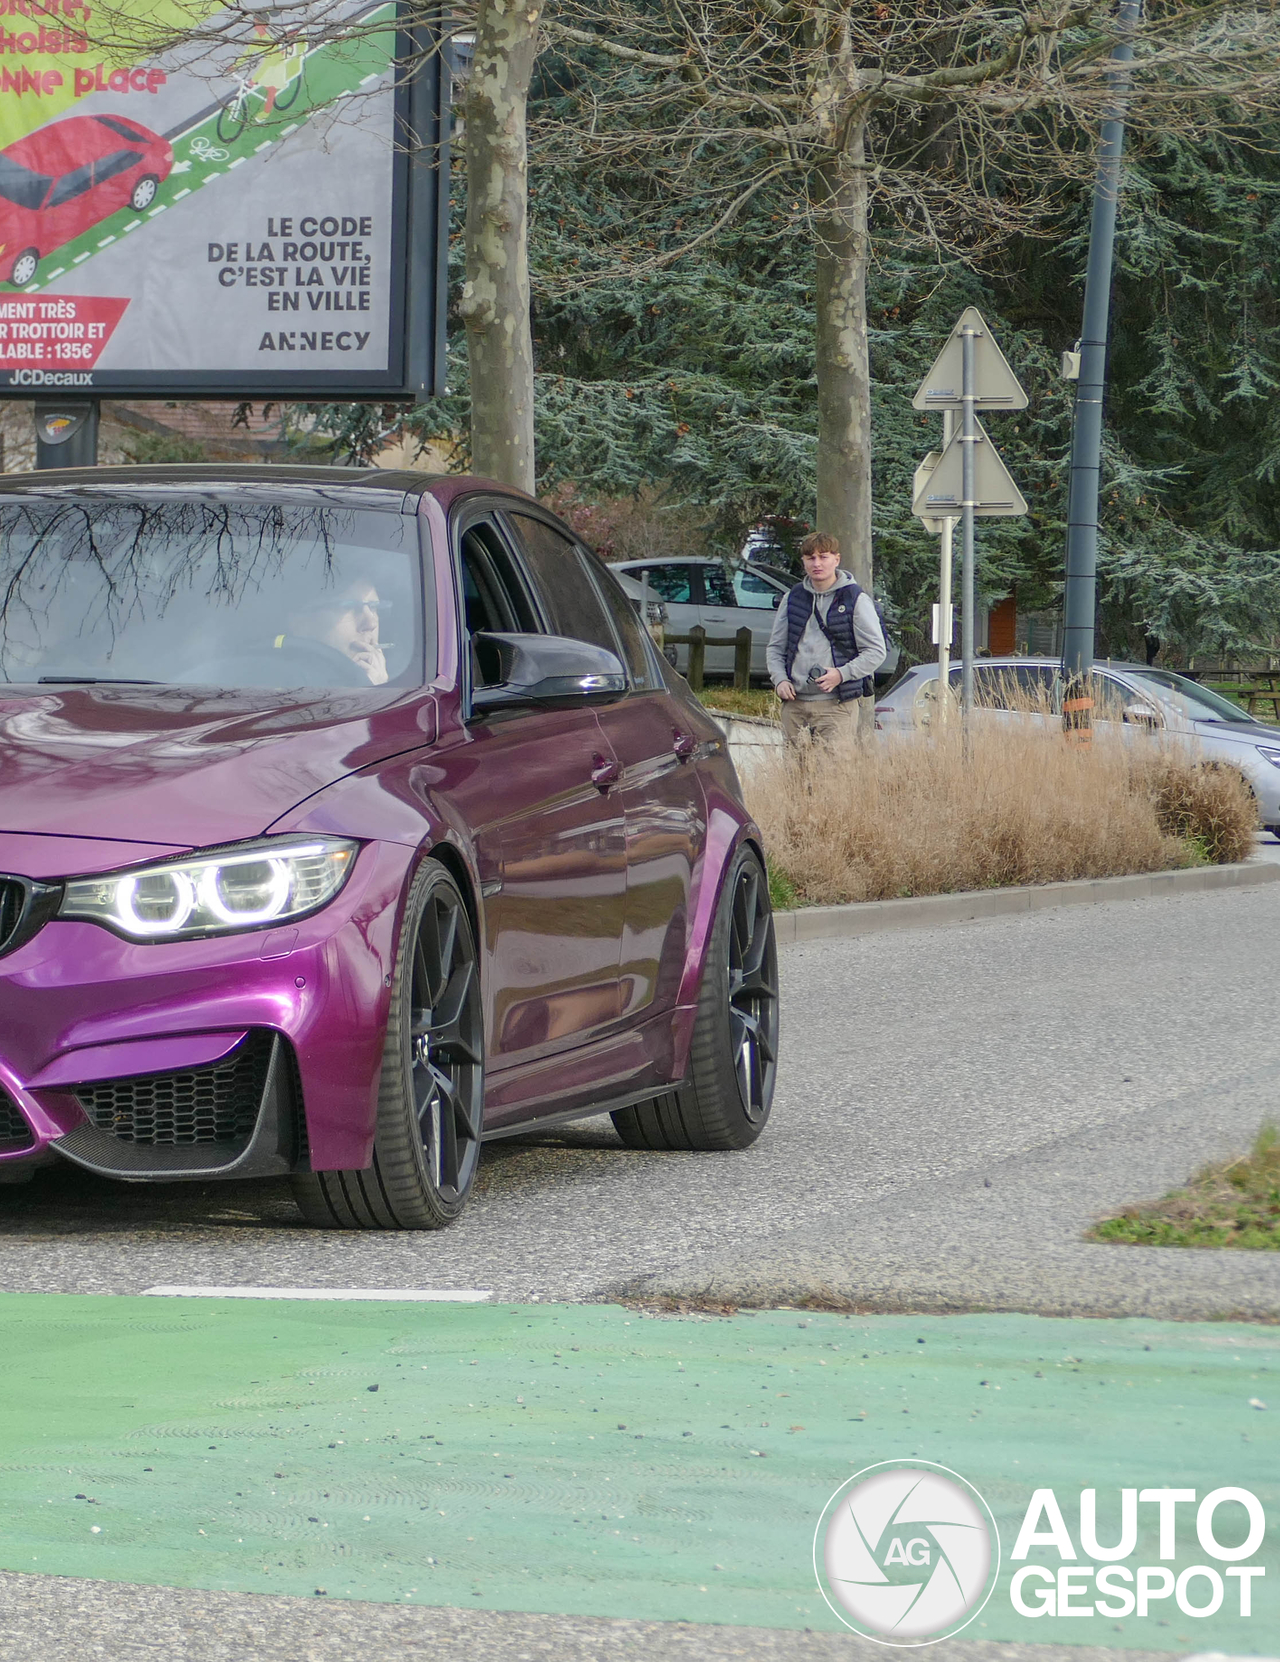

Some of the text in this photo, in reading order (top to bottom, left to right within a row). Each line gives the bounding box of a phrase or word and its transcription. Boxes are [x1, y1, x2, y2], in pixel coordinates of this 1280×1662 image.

[267, 216, 372, 237] LE CODE
[208, 241, 372, 266] DE LA ROUTE,
[218, 266, 371, 287] C’EST LA VIE
[38, 299, 76, 319] TRÈS
[267, 291, 370, 311] EN VILLE
[10, 322, 84, 339] TROTTOIR
[88, 322, 106, 339] ET
[54, 343, 93, 359] 135€
[258, 331, 371, 351] ANNECY
[9, 368, 93, 386] JCDecaux
